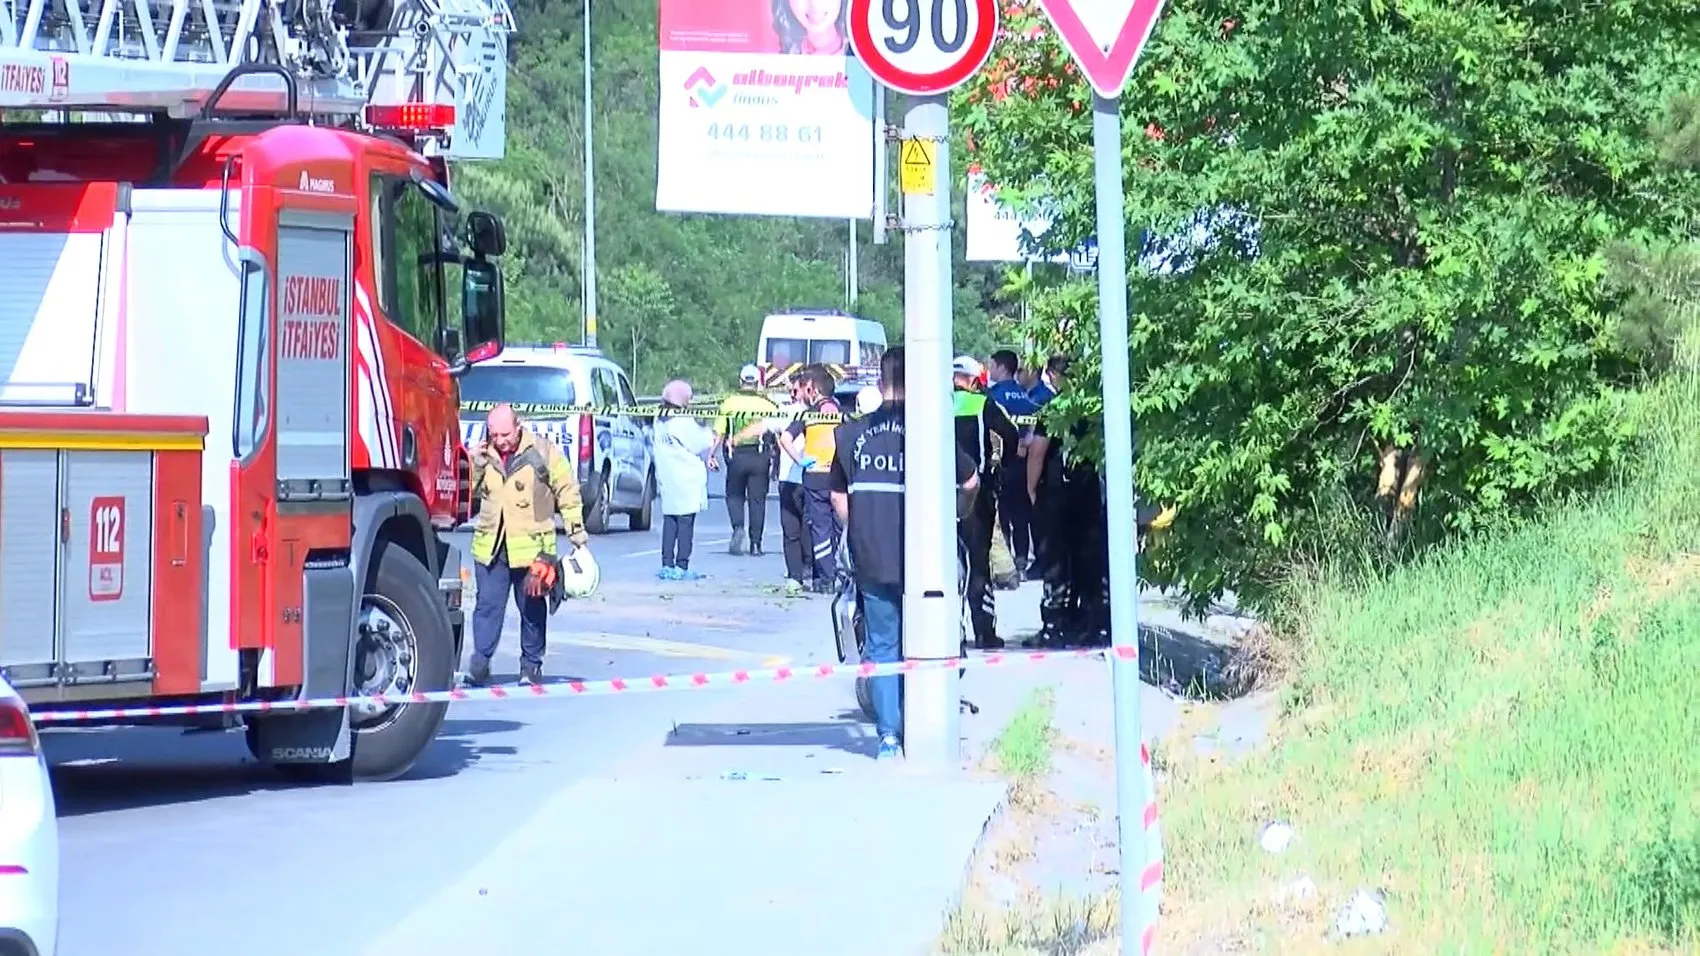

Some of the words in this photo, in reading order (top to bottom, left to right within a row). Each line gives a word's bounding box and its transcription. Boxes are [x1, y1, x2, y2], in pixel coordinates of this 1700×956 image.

[882, 0, 967, 53] 90
[707, 122, 750, 142] 444
[759, 124, 789, 143] 88
[797, 126, 824, 144] 61
[95, 506, 121, 553] 112
[271, 747, 333, 760] SCANIA
